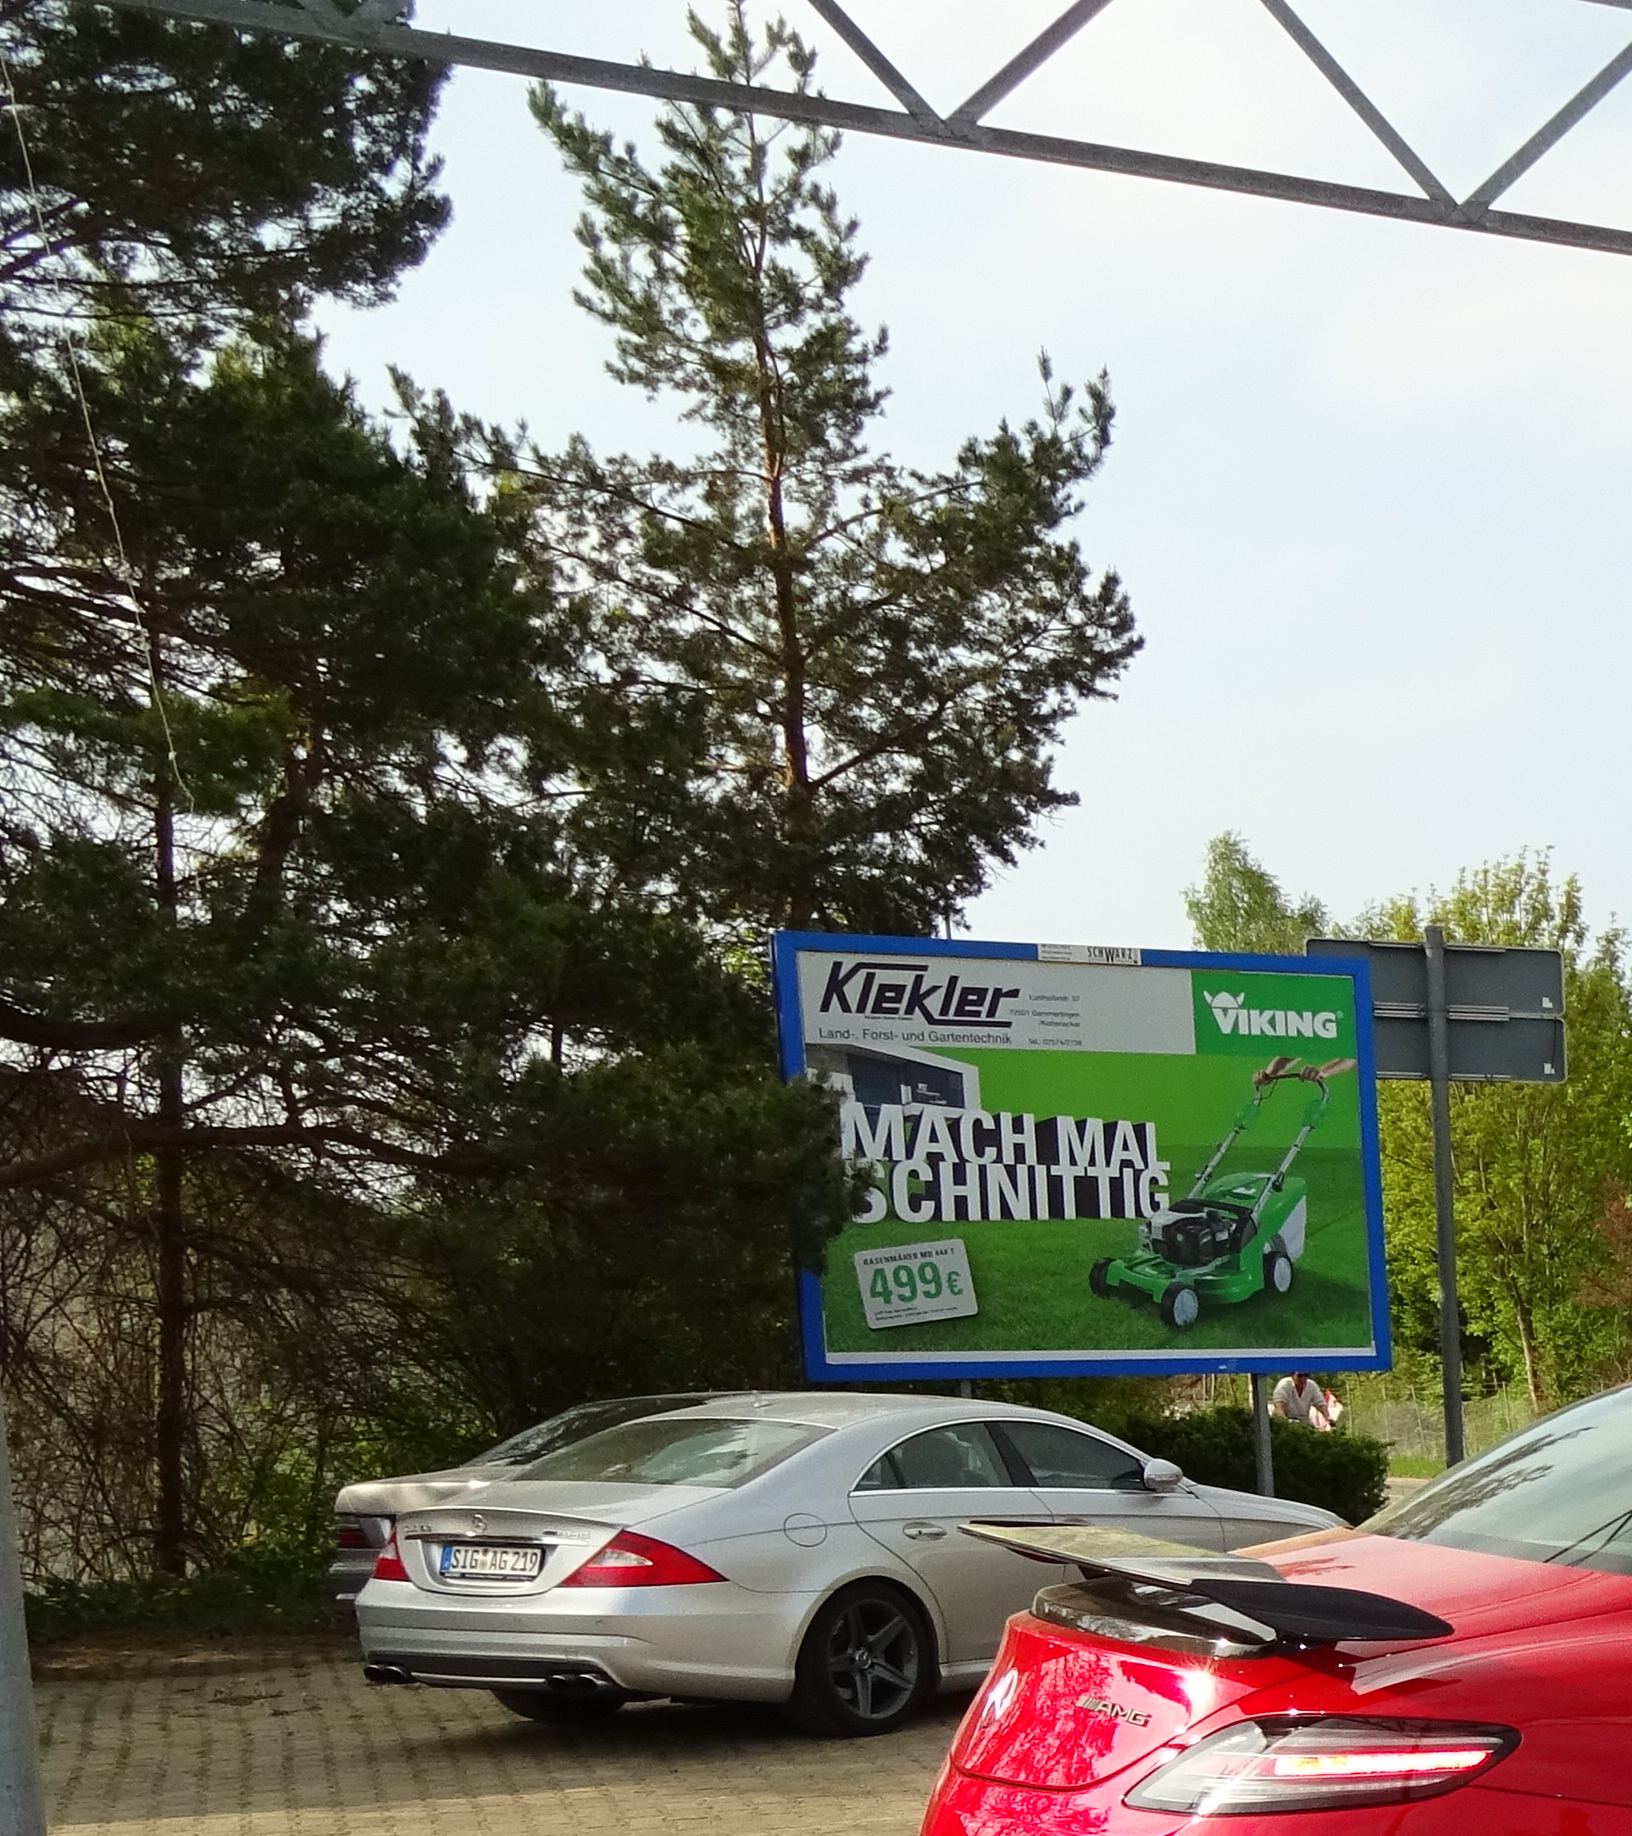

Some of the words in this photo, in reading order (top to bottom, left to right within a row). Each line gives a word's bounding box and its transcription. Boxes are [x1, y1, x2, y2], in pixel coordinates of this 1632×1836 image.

[1087, 945, 1132, 963] SCHWARZ
[819, 1027, 859, 1040] Land-,
[863, 1028, 899, 1041] Forst-
[902, 1030, 925, 1042] und
[929, 1030, 1013, 1044] Gartentechnik
[1211, 1008, 1338, 1039] VIKING
[840, 1102, 1038, 1166] MACH
[1056, 1115, 1171, 1177] MAL
[846, 1157, 1170, 1224] SCHNITTIG
[451, 1548, 481, 1570] SIG
[489, 1549, 509, 1570] AG
[511, 1551, 539, 1572] 219
[1095, 1700, 1152, 1728] AMG
